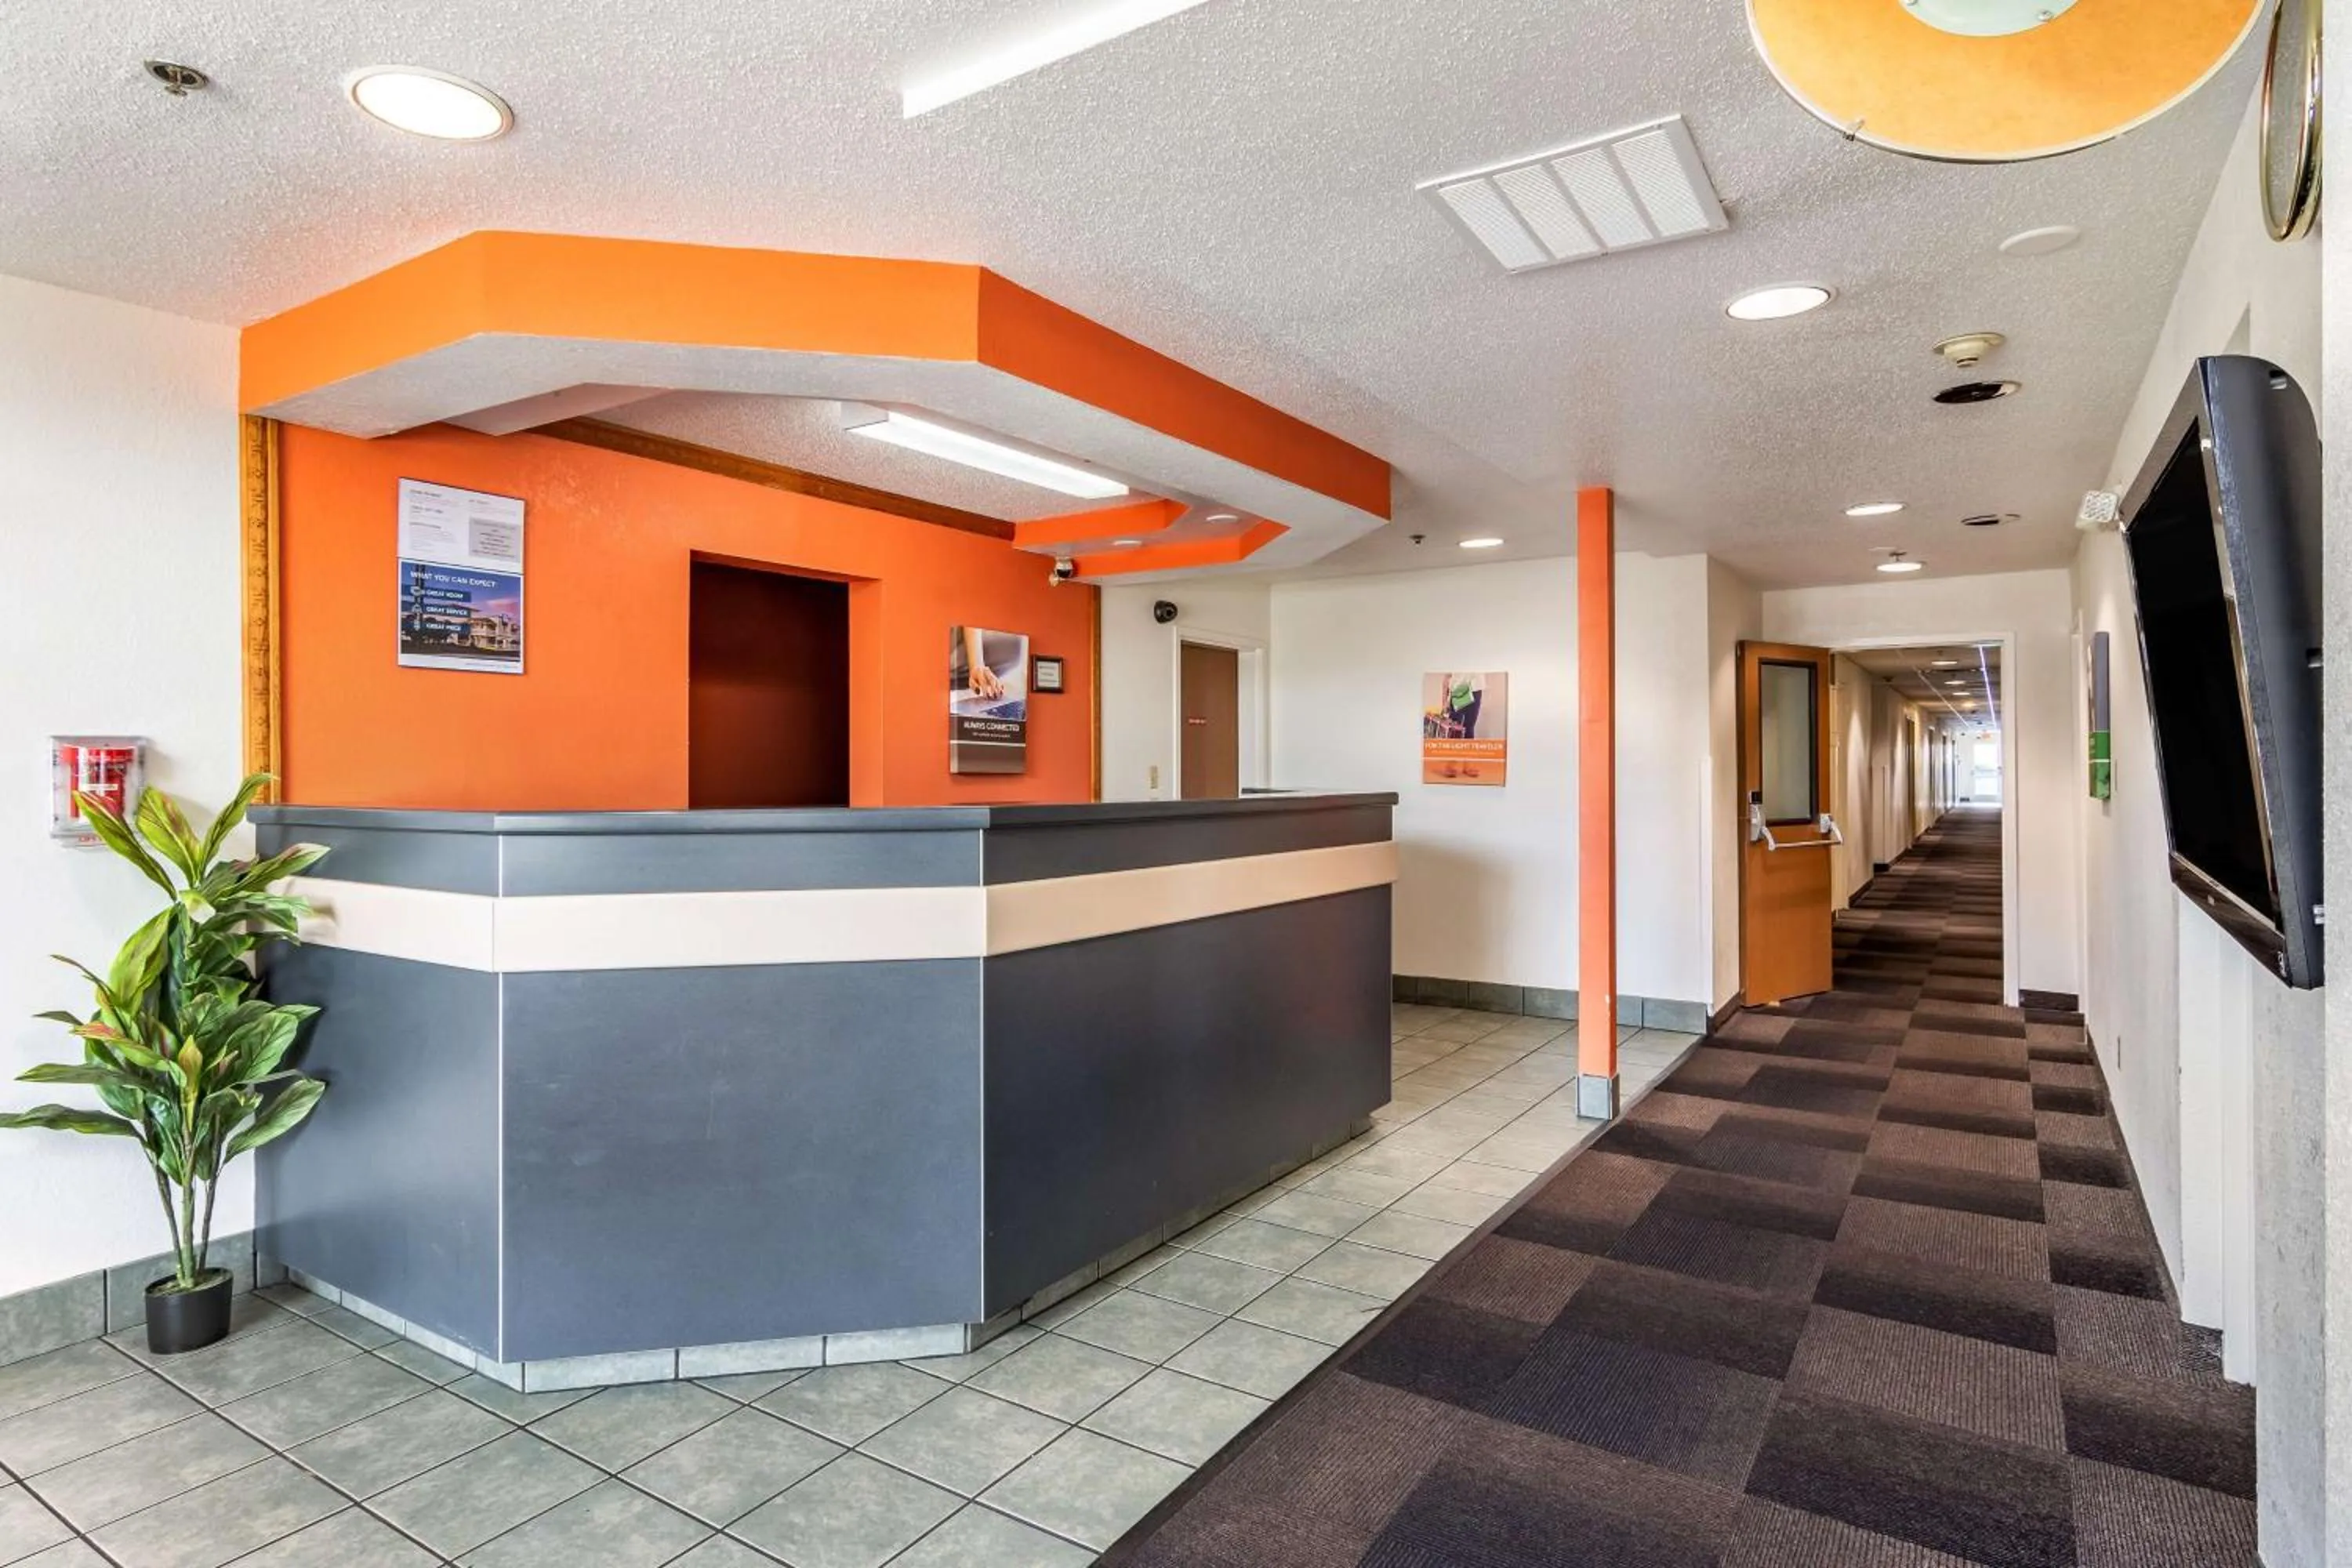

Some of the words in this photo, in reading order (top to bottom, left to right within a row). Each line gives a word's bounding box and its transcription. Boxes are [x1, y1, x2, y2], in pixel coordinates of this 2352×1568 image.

[410, 571, 433, 580] WHAT
[470, 579, 496, 587] EXPECT
[986, 722, 1020, 731] CONNECTED
